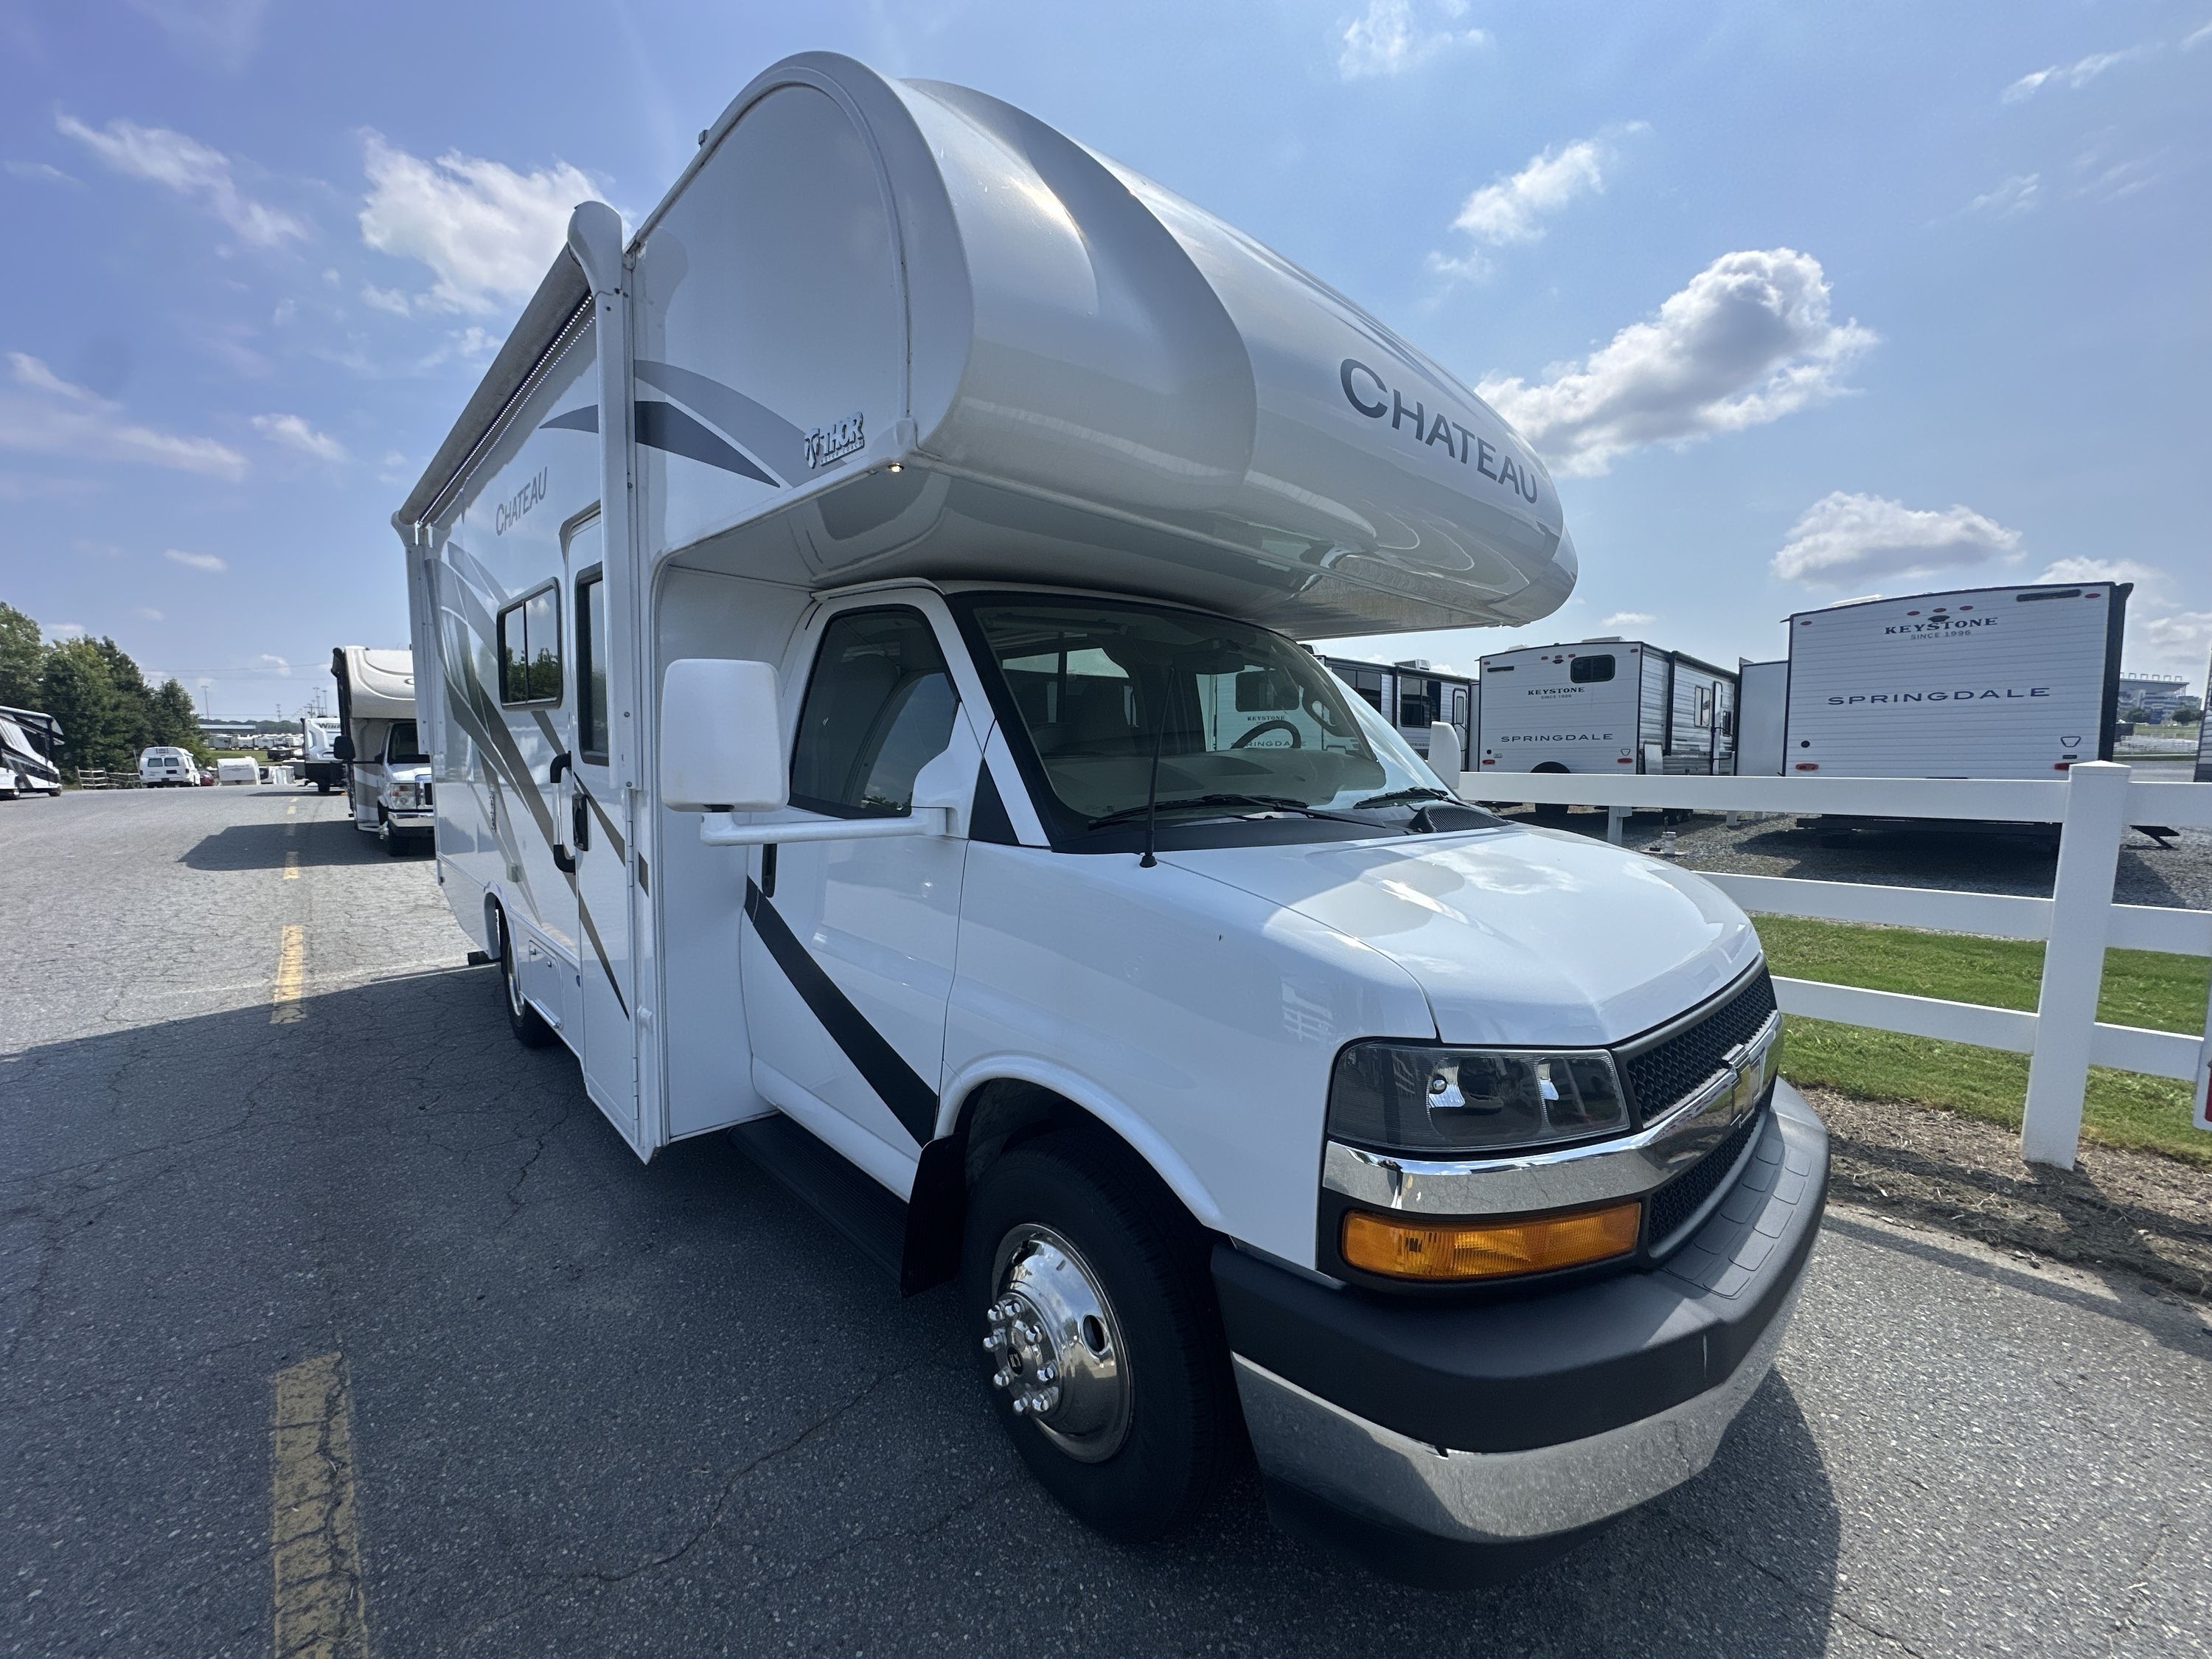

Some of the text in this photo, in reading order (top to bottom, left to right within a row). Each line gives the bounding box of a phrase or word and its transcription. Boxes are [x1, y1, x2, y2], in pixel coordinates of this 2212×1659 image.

[815, 412, 864, 456] THOR
[1340, 358, 1538, 504] CHATEAU
[495, 465, 548, 537] CHATEAU
[1884, 616, 1998, 635] KEYSTONE
[1910, 629, 1972, 640] SINCE 1996
[1528, 686, 1585, 695] KEYSTONE
[1827, 687, 2051, 706] SPRINGDALE
[1501, 734, 1613, 742] SPRINGDALE
